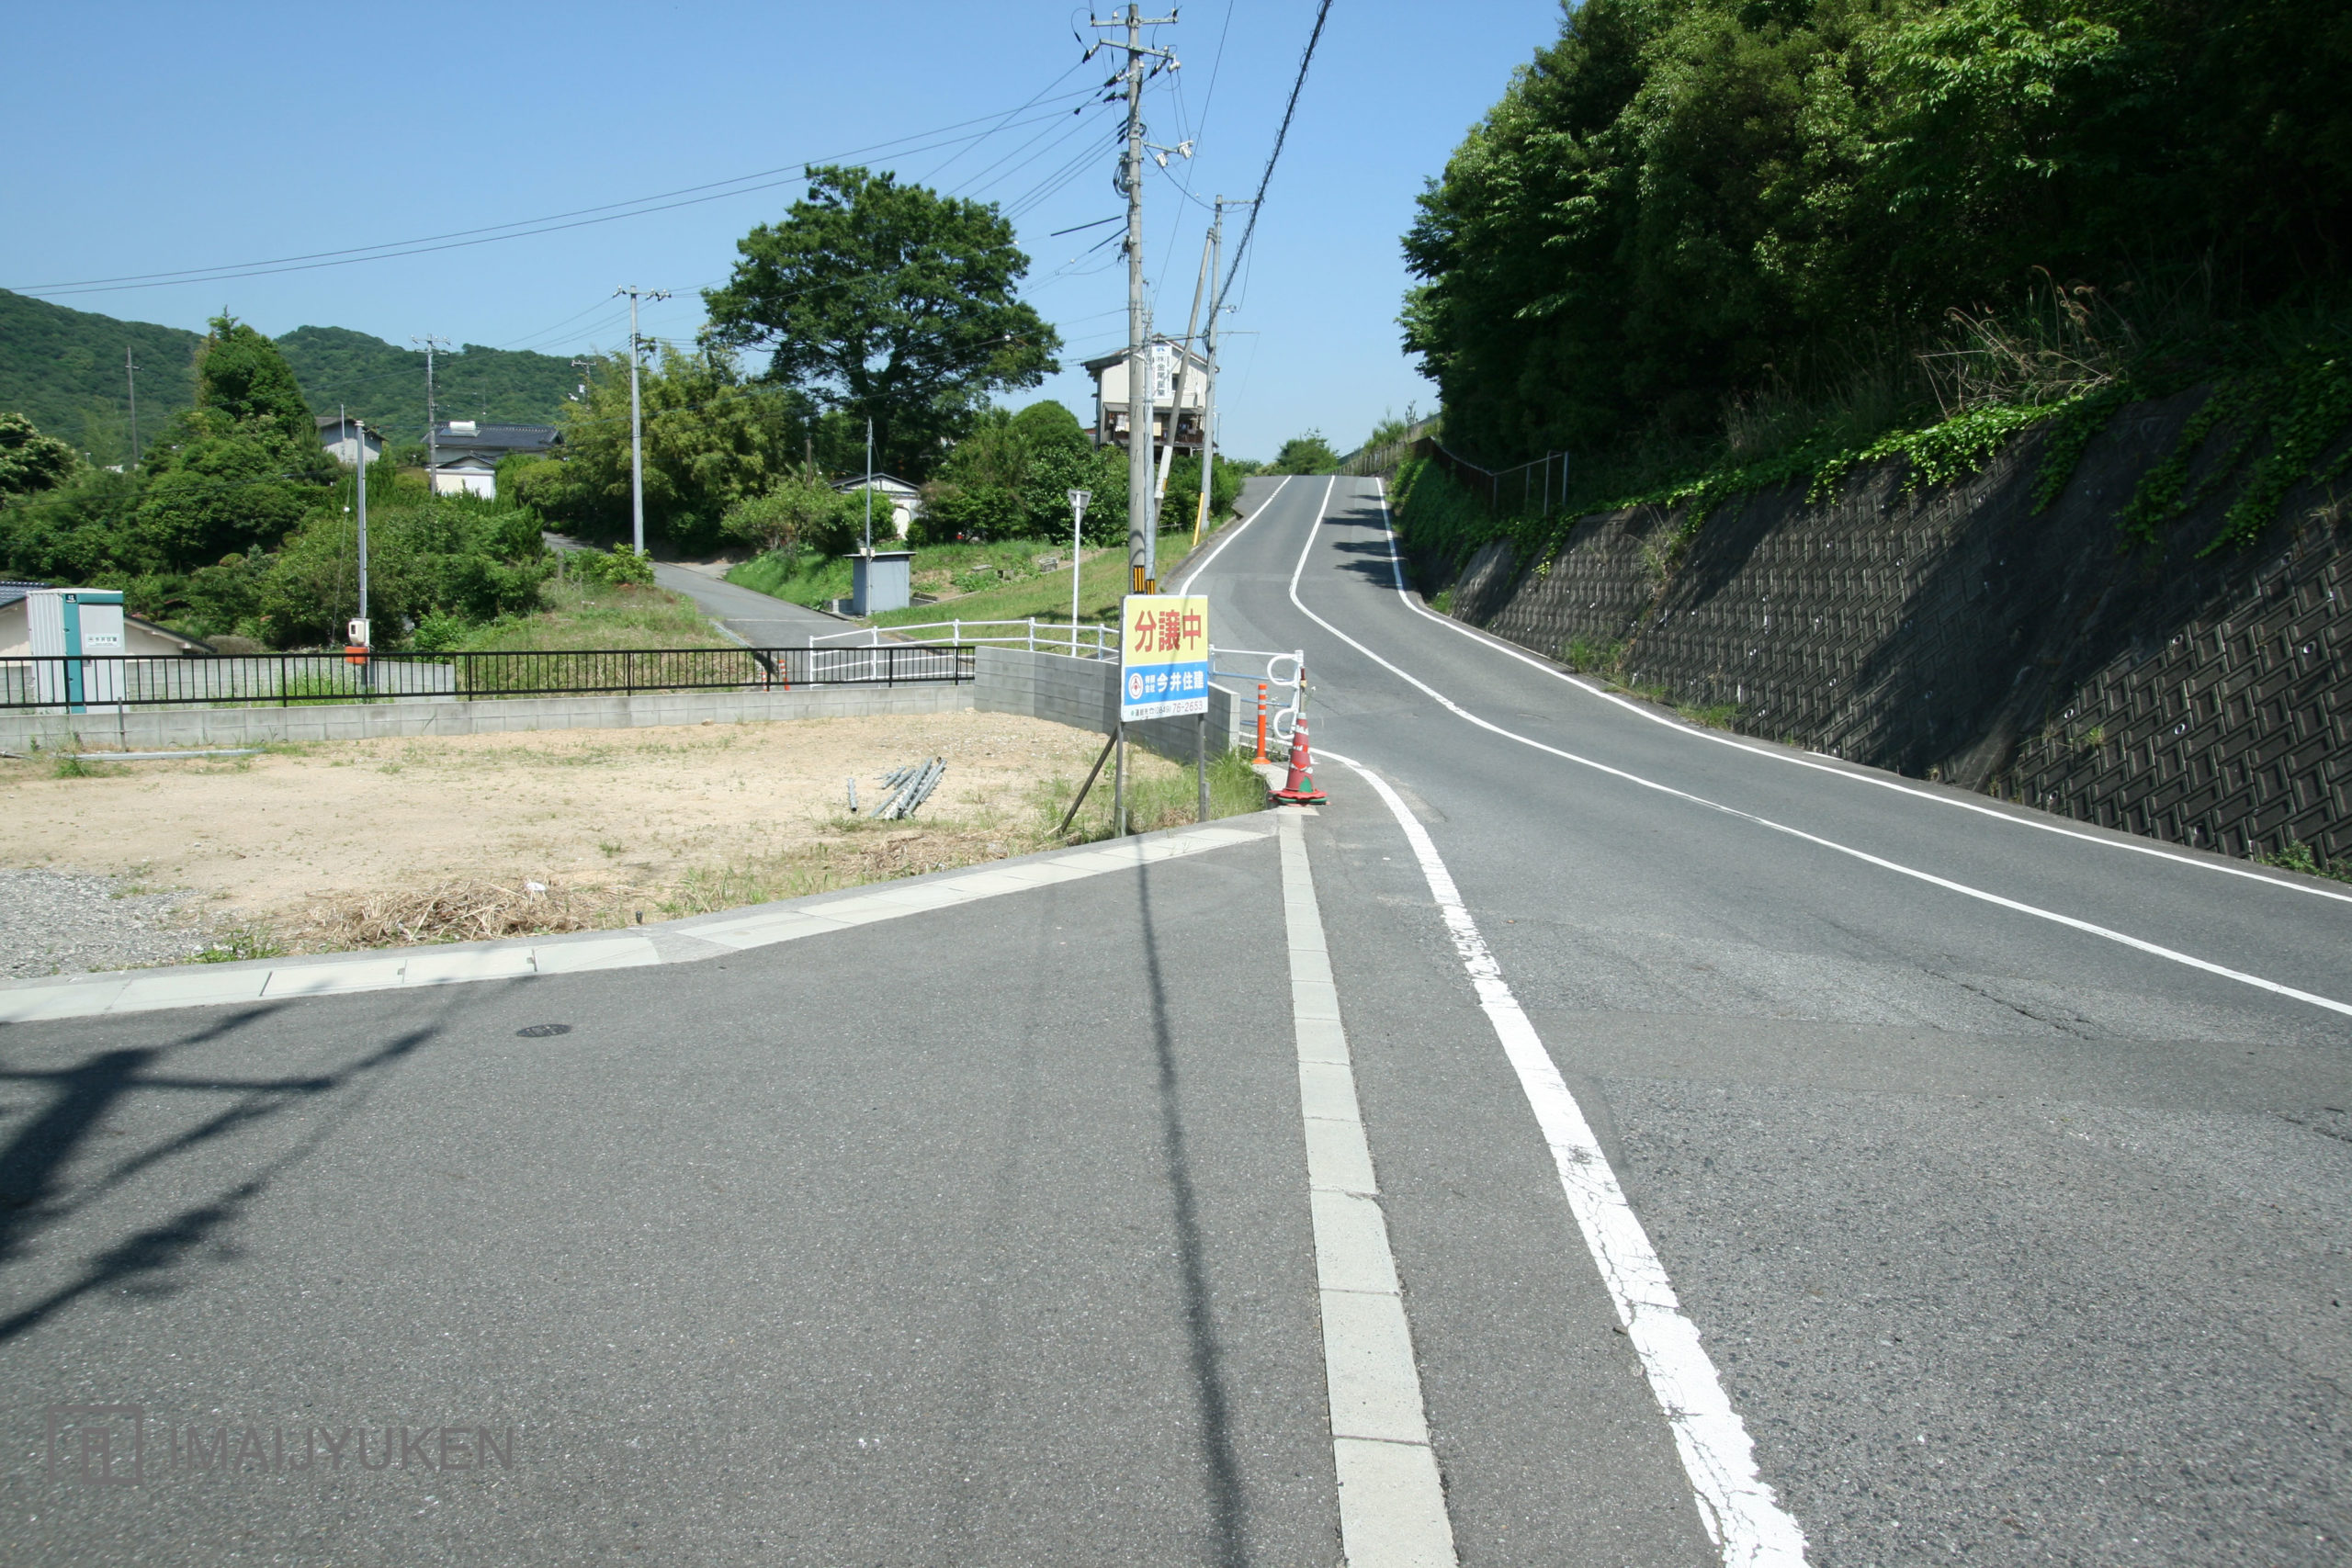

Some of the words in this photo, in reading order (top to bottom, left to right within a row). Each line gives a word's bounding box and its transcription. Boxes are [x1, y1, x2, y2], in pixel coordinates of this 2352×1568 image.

[1134, 608, 1202, 652] 分譲中
[1157, 671, 1204, 694] 今井住建
